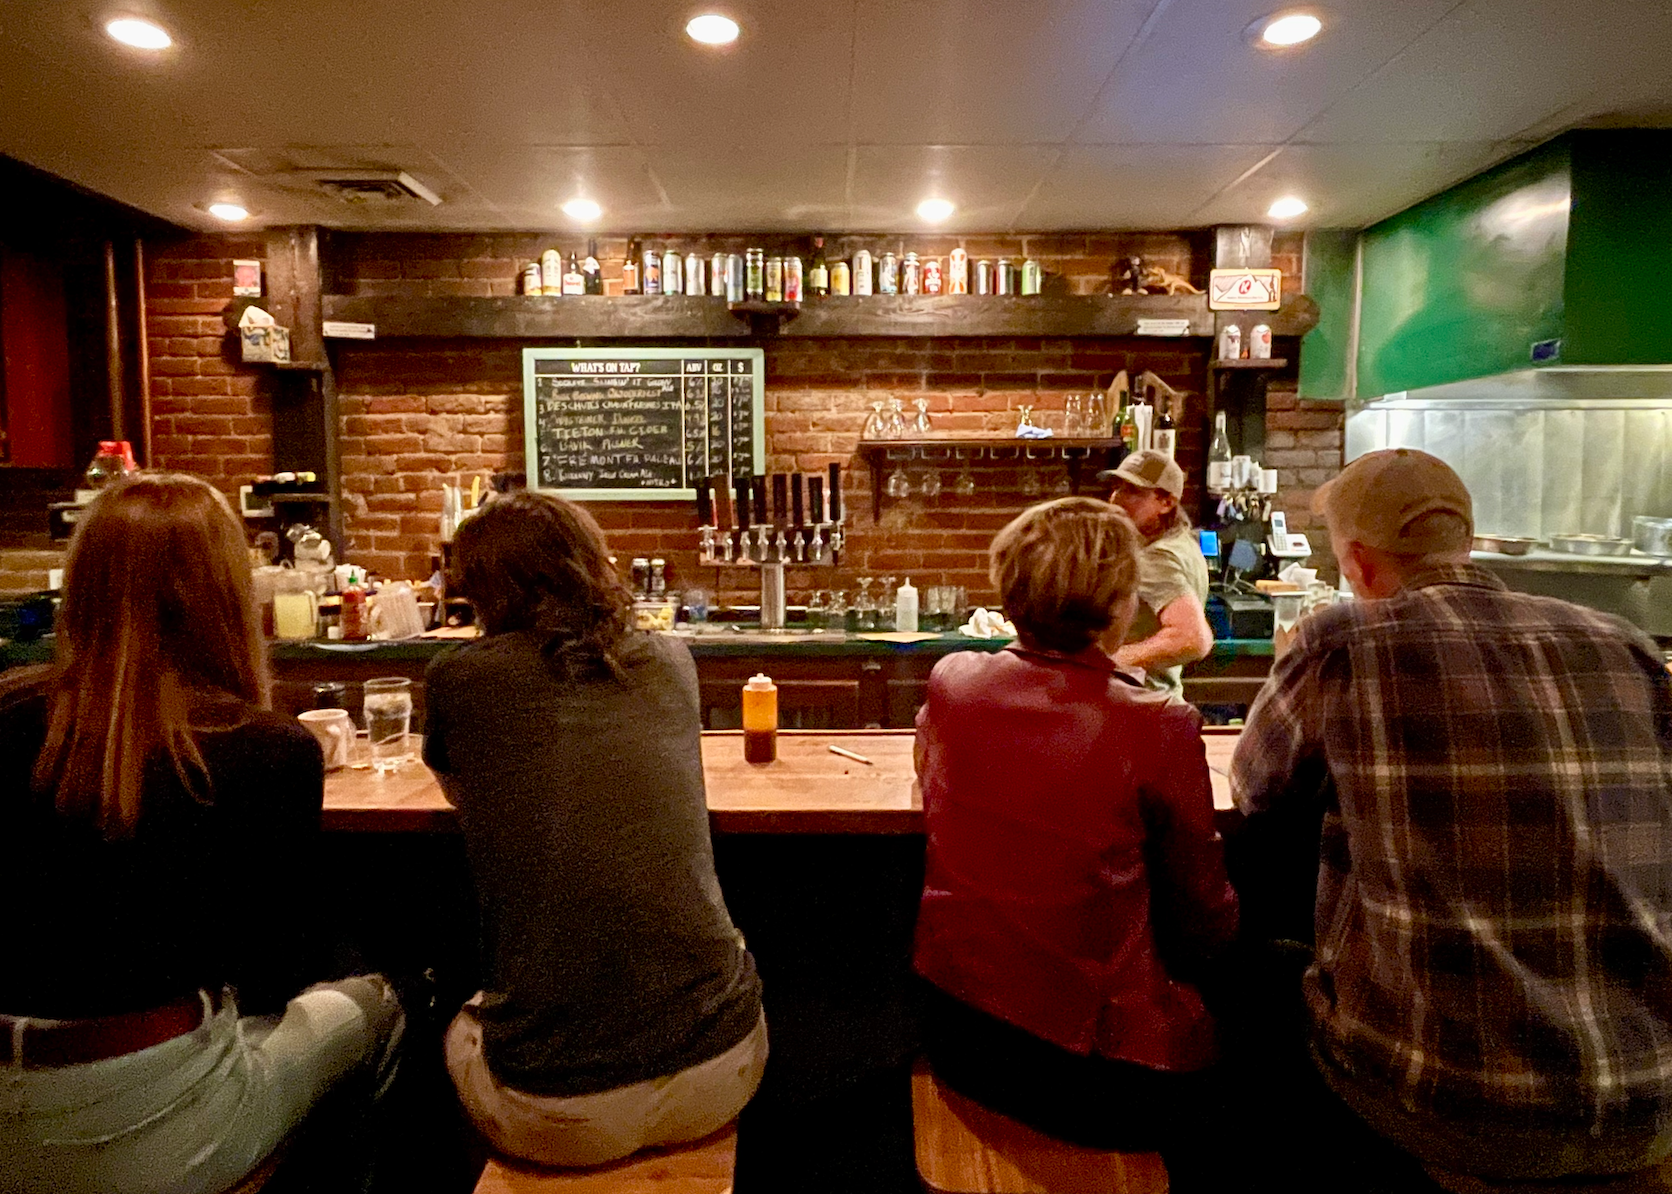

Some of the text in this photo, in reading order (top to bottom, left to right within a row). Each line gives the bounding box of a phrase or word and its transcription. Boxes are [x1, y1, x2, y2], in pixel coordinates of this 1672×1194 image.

[571, 362, 641, 373] WHAT'S ON TAP?
[686, 362, 702, 373] ABV
[629, 425, 668, 436] CIDER
